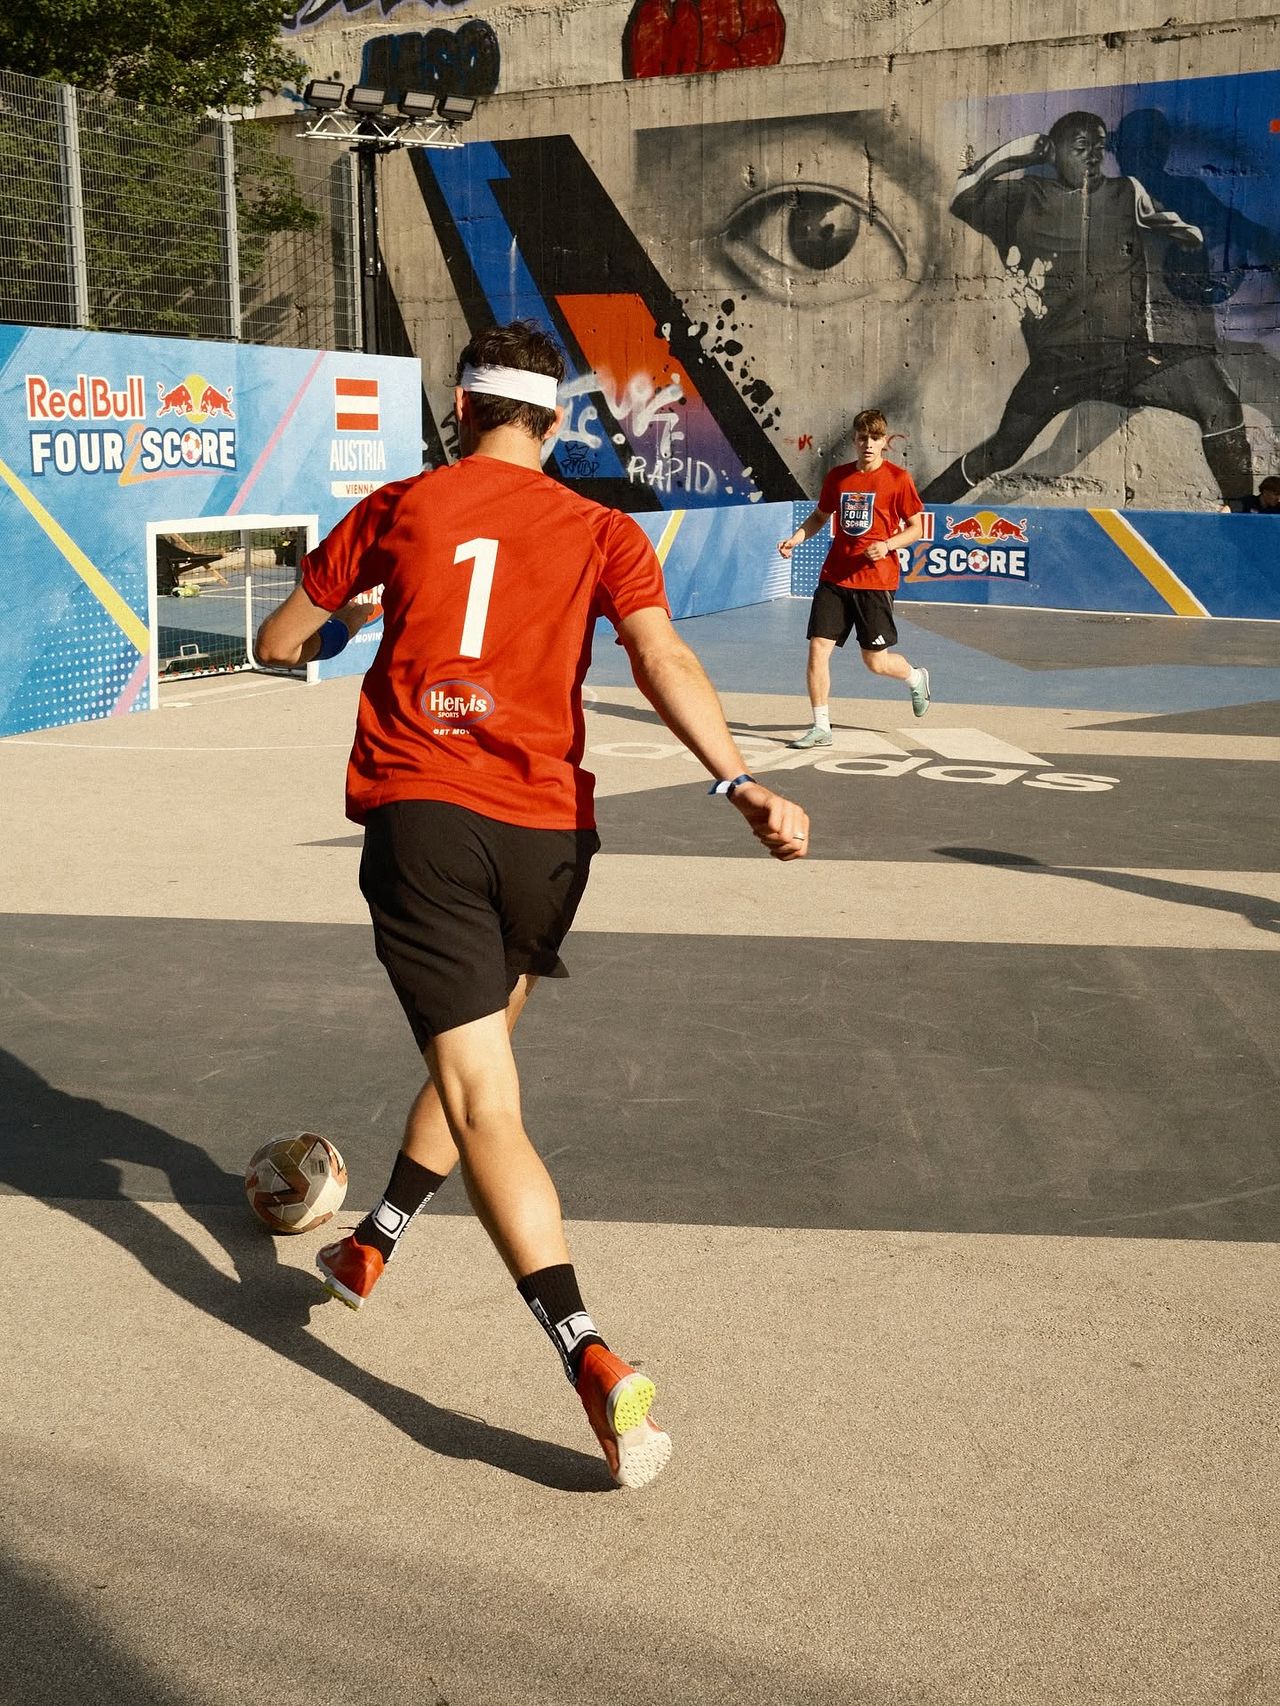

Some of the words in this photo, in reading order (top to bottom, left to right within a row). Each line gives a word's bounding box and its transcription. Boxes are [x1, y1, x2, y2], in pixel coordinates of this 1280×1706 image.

[27, 376, 86, 419] Red
[90, 377, 145, 419] Bull
[30, 430, 125, 475] FOUR
[141, 429, 236, 470] SCORE
[329, 439, 386, 471] AUSTRIA
[345, 484, 375, 495] VIENNA
[627, 455, 718, 494] RAPID
[844, 510, 869, 520] FOUR
[928, 547, 1027, 578] SCORE
[453, 537, 499, 659] 1
[355, 631, 384, 643] MOVIN
[430, 691, 487, 716] Hervis
